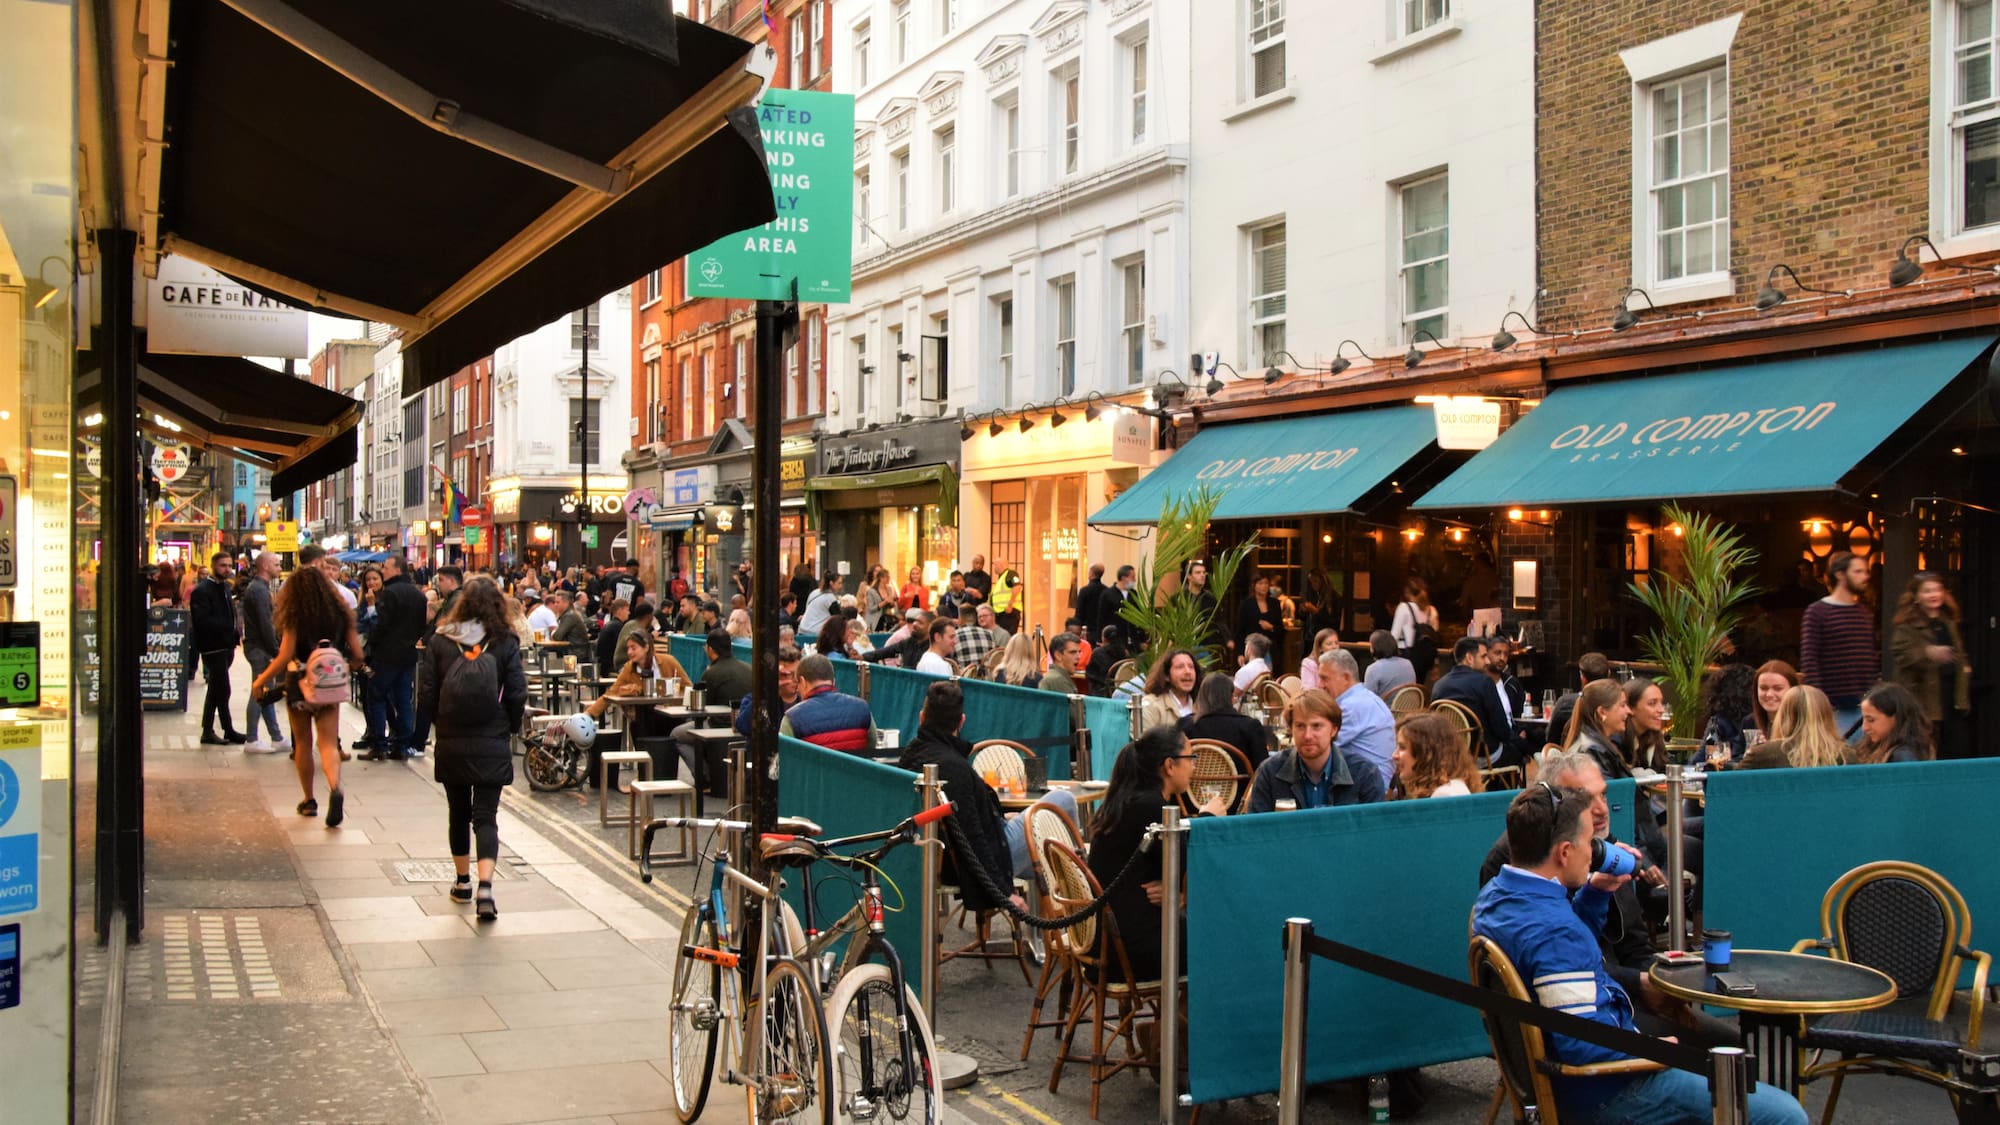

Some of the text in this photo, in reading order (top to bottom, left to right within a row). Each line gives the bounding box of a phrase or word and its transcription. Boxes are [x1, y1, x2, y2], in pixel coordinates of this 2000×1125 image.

[760, 108, 812, 124] ATED
[760, 128, 825, 147] NKING
[766, 151, 795, 166] ND
[773, 173, 811, 190] ING
[777, 195, 799, 210] LY
[743, 237, 797, 254] AREA
[226, 292, 239, 302] DE
[242, 290, 292, 309] NA
[1441, 413, 1497, 425] OLD COMPTON
[1550, 402, 1837, 450] OLD COMPTON
[825, 439, 912, 474] The Vintage House
[1569, 441, 1742, 464] BRASSERIE
[1196, 447, 1359, 480] OLD COMPTON
[146, 633, 185, 646] PPIEST
[16, 674, 27, 689] 5
[161, 690, 180, 700] £12
